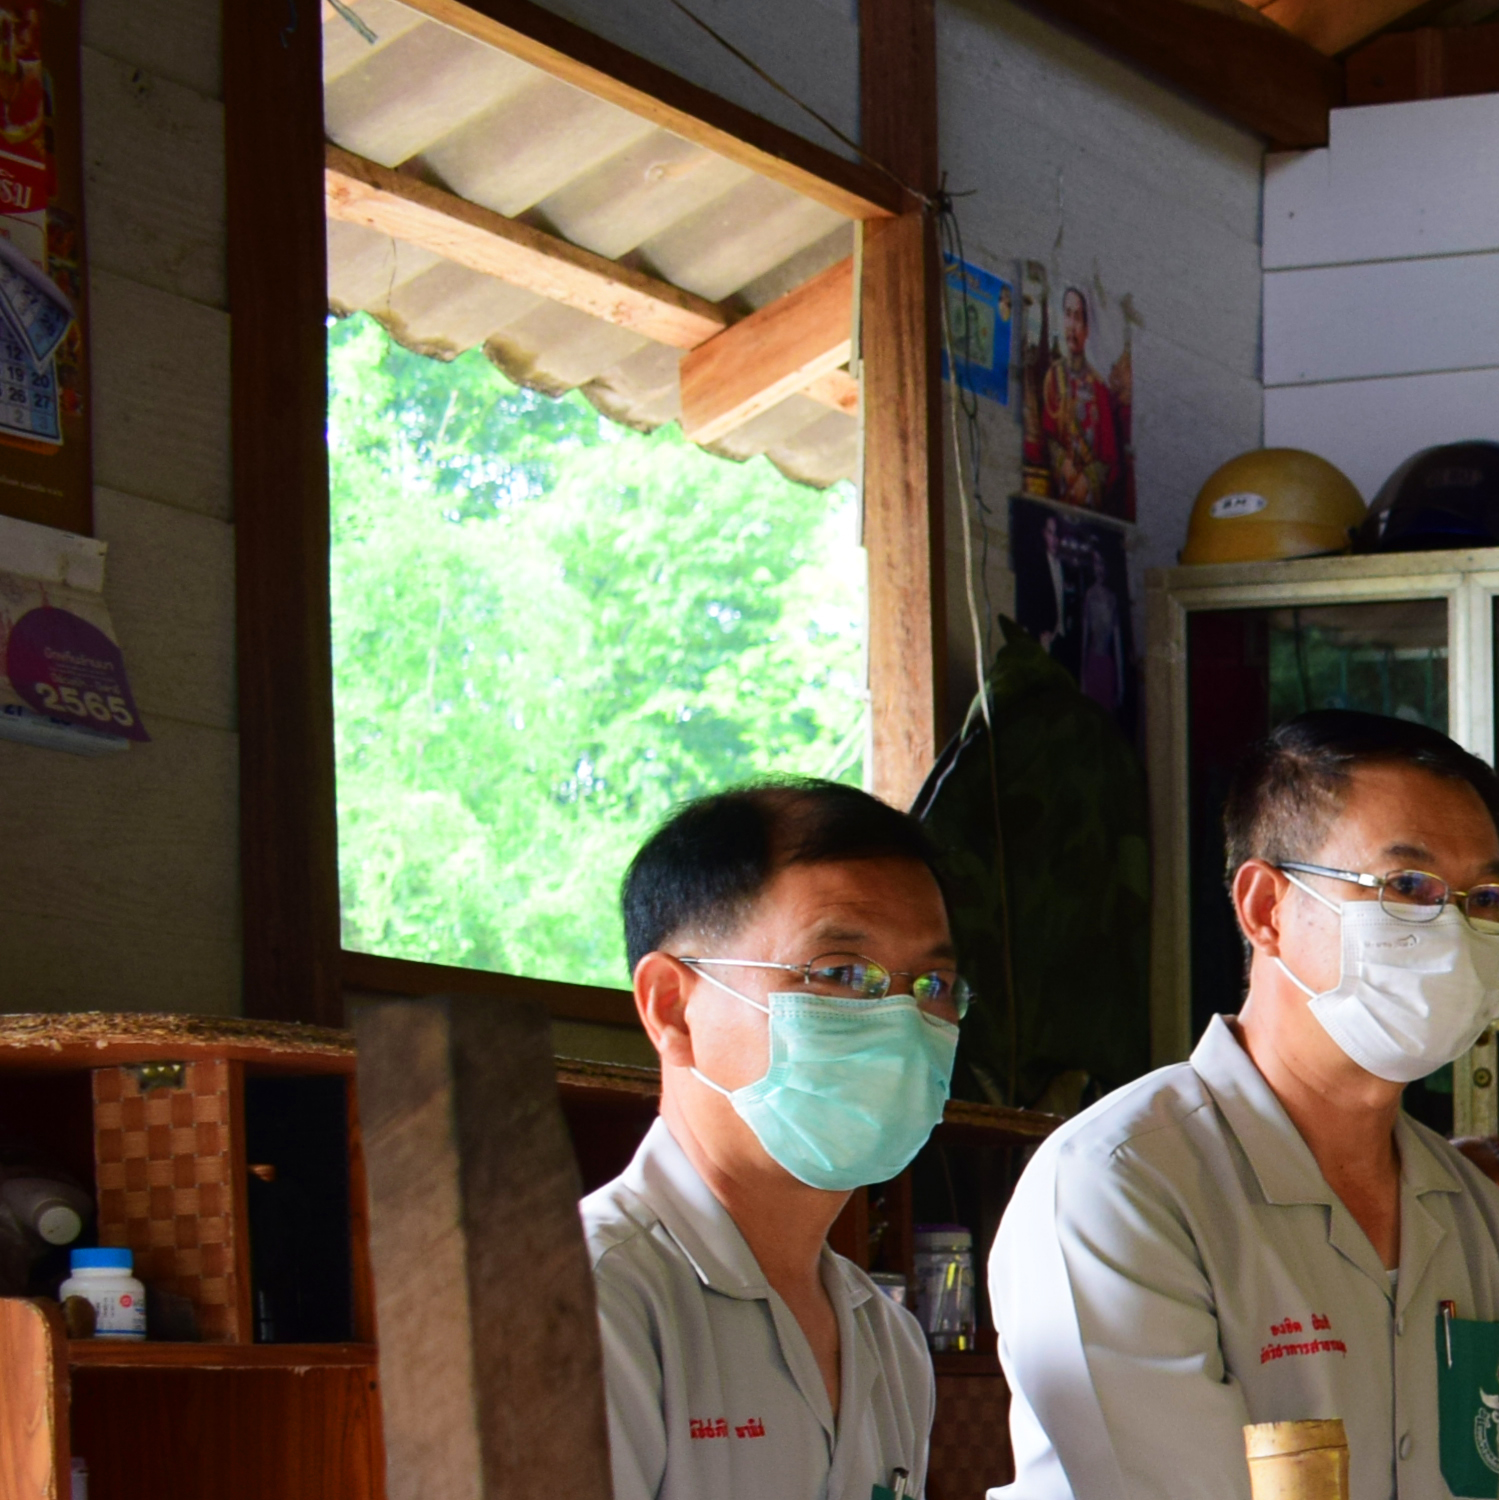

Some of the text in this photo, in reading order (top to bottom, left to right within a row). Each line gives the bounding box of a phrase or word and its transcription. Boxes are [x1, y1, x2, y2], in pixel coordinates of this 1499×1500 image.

[5, 342, 23, 360] 12
[7, 366, 50, 388] 19 20
[9, 387, 51, 409] 26 27
[34, 682, 134, 727] 2565
